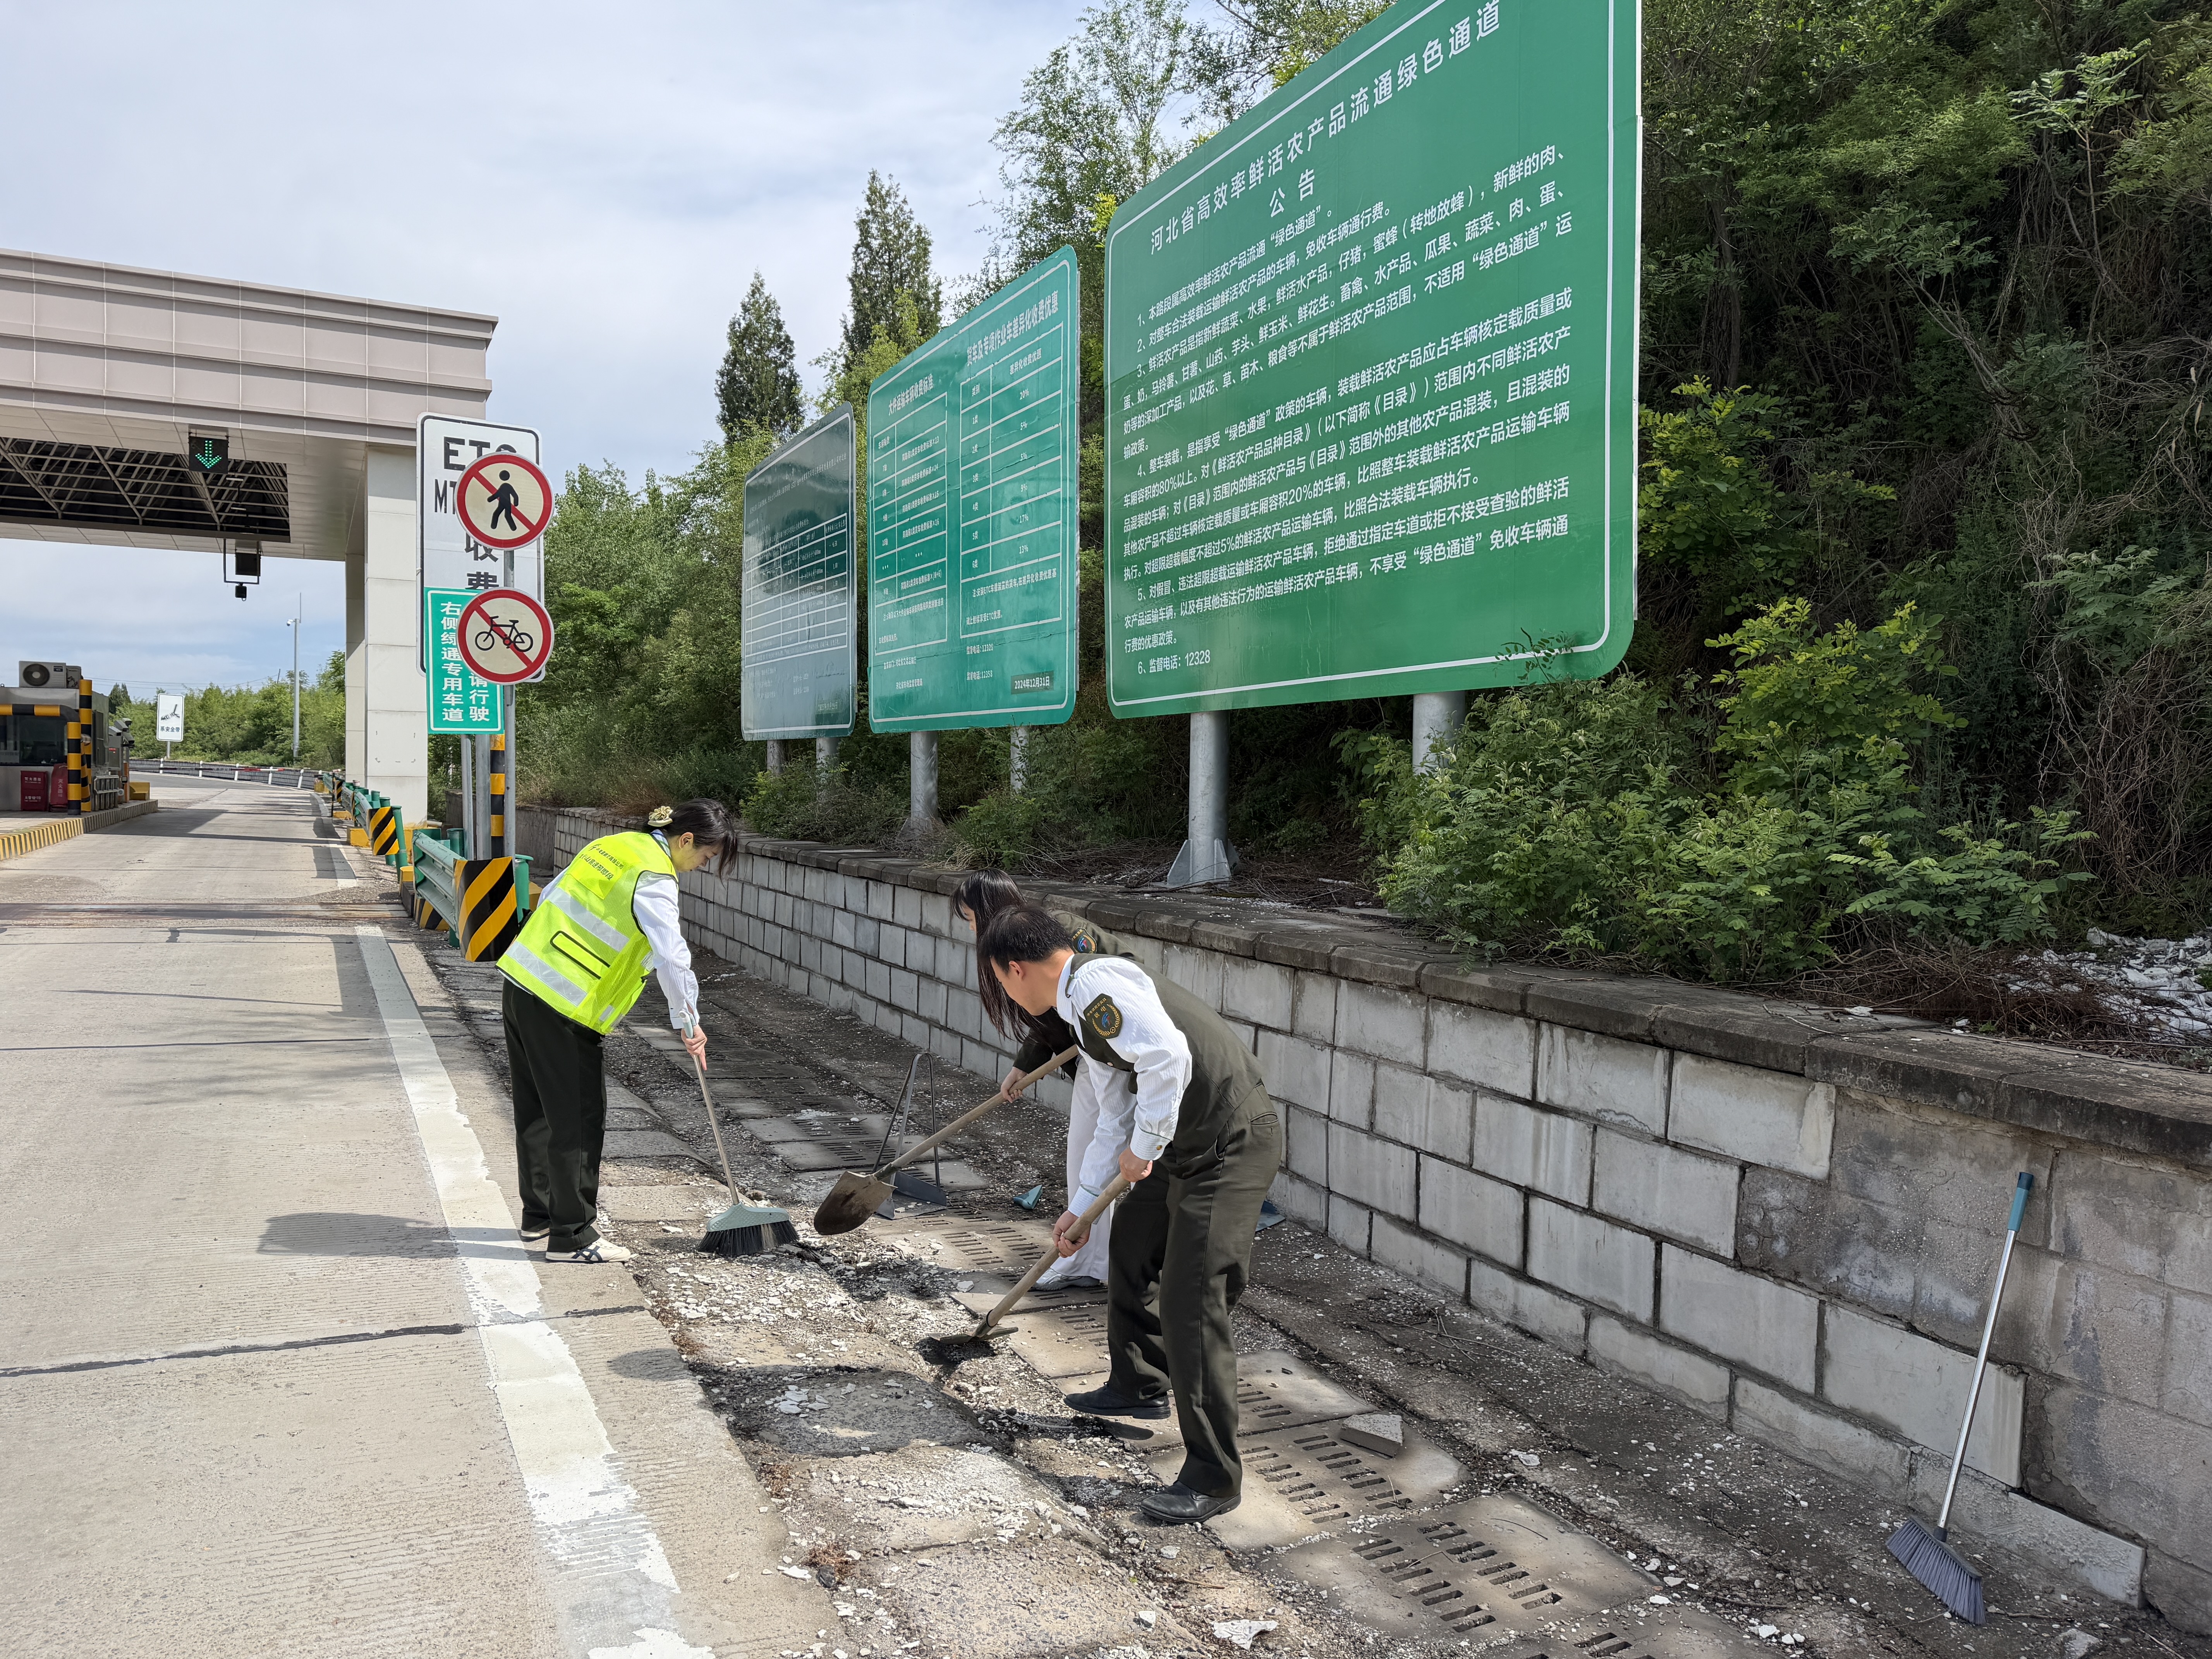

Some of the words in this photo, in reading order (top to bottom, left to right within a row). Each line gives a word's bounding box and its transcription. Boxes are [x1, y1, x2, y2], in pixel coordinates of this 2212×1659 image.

[1151, 0, 1499, 255] 河北省高效率鲜活农产品流通绿色通道
[1269, 169, 1315, 218] 公告
[1137, 201, 1389, 353] 2、对整车合法装载运输鲜活农产品的车辆，免收车辆通行费。
[967, 290, 1058, 368] 货车及专项作业车差异化收费优惠
[1010, 348, 1041, 375] 差异化收费优惠
[888, 373, 934, 416] 大件运输车辆收费标准
[972, 383, 980, 397] 类别
[1020, 388, 1029, 400] 20%
[1020, 421, 1028, 430] 5%
[443, 436, 517, 471] ET
[1020, 452, 1028, 461] 5%
[1123, 438, 1148, 460] 输政策。
[1021, 483, 1028, 492] 9%
[1020, 513, 1029, 523] 17%
[1019, 544, 1029, 554] 13%
[1124, 630, 1176, 653] 行费的优惠政策。
[440, 601, 464, 721] 右侧绿通专用车道
[1138, 649, 1211, 674] 6、监督电话：12328
[1015, 676, 1050, 689] 2024年12月31日
